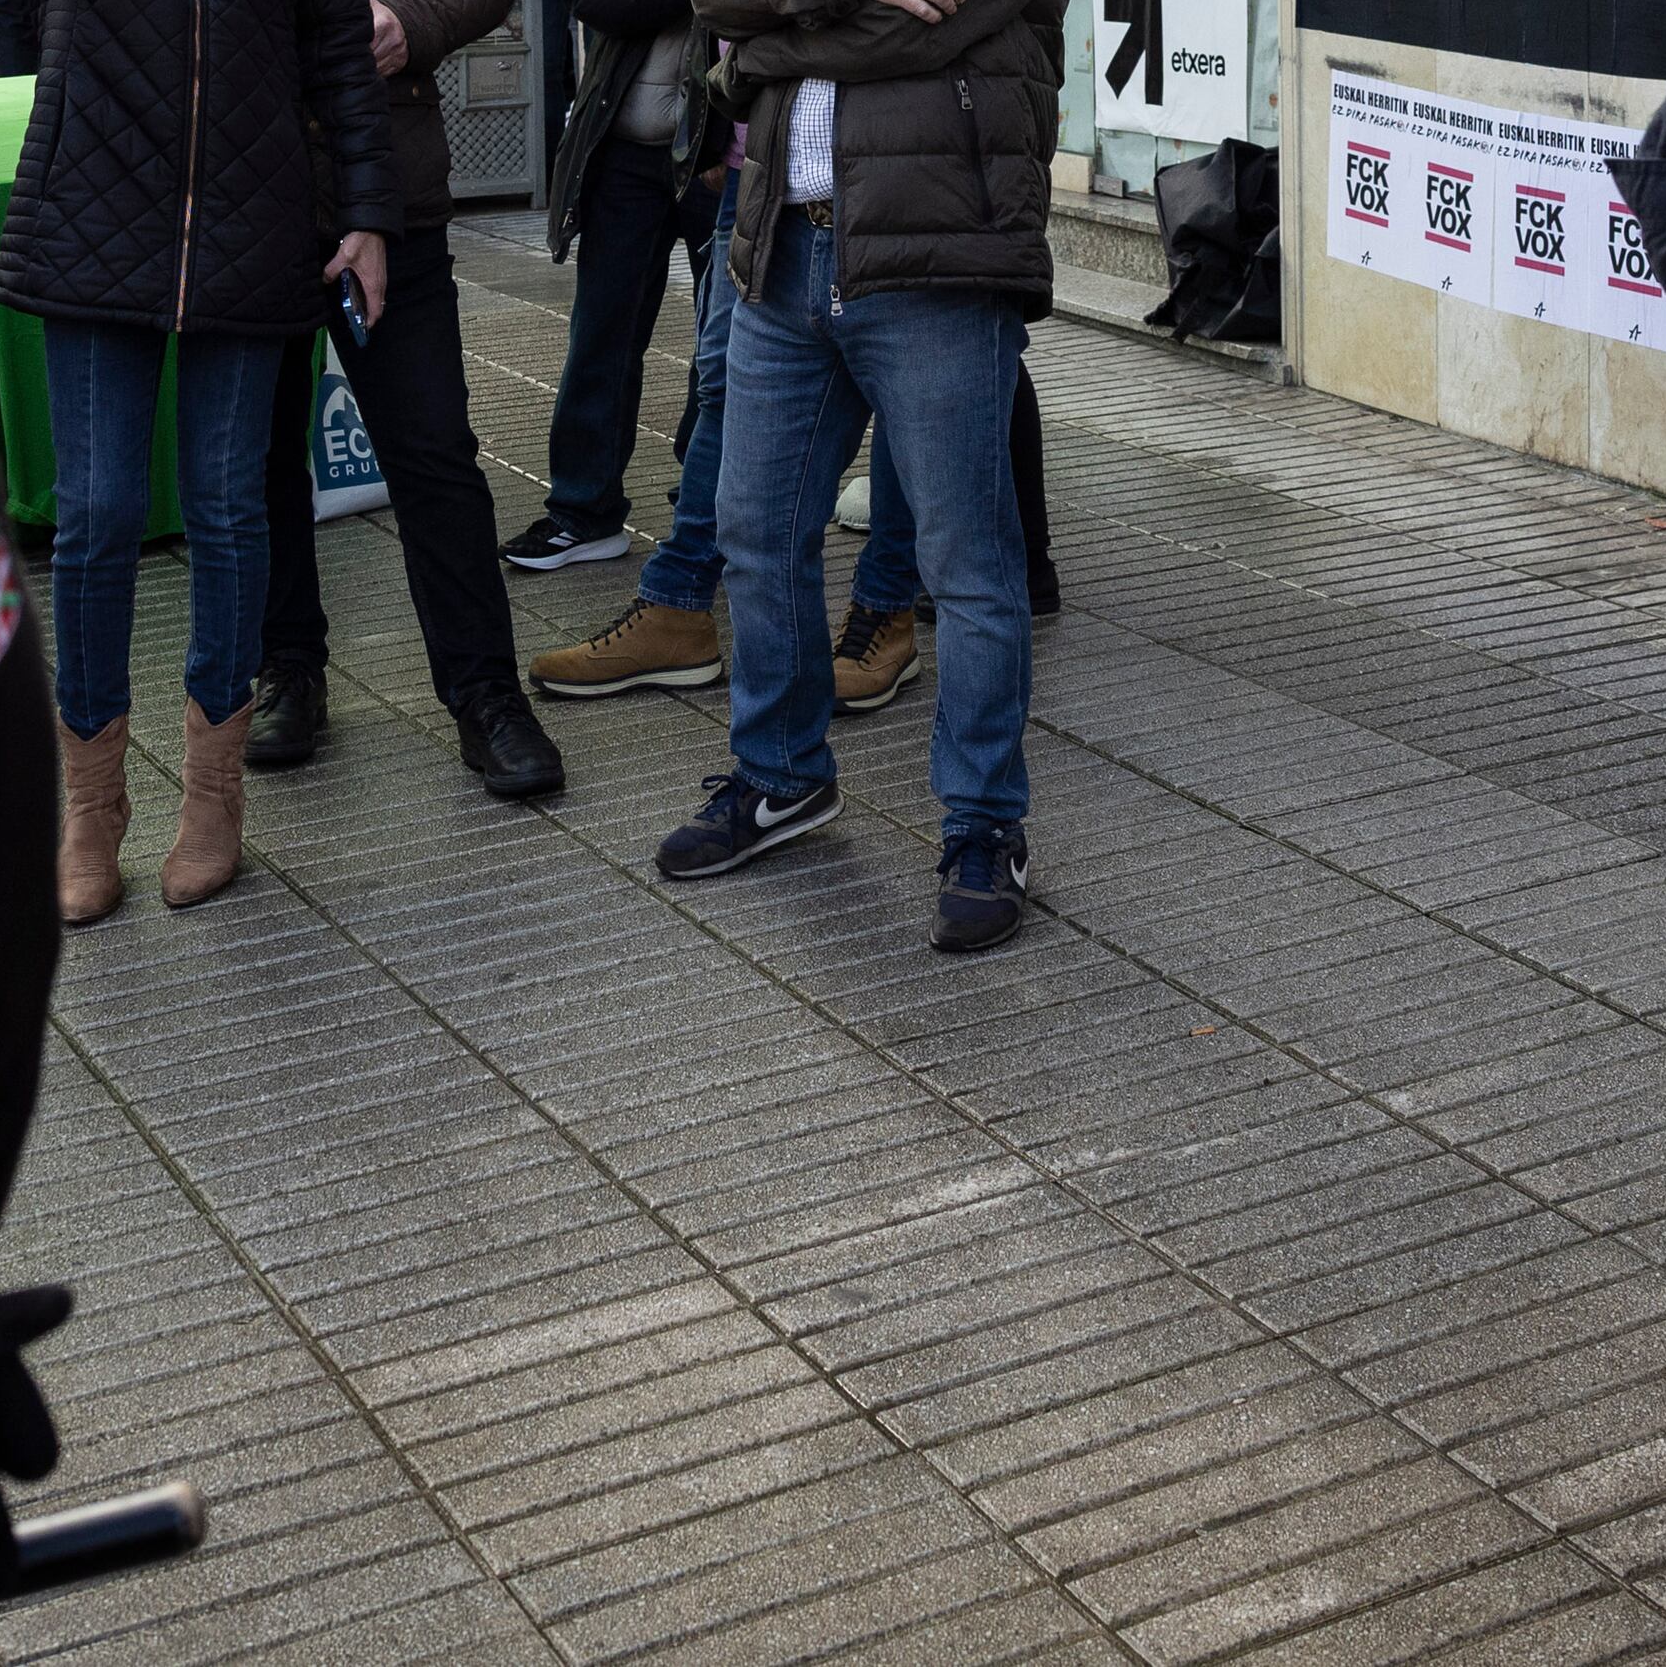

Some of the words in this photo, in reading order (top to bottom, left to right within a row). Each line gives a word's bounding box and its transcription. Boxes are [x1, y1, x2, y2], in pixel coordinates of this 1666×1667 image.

[1171, 47, 1226, 77] etxera
[1332, 104, 1344, 116] EZ
[1346, 108, 1367, 122] DIRA
[1411, 124, 1425, 136] EZ
[1426, 127, 1448, 143] DIRA
[1497, 145, 1512, 157] EZ
[1513, 148, 1536, 164] DIRA
[1589, 161, 1605, 174] EZ
[1334, 83, 1365, 105] EUSKAL
[1367, 91, 1409, 115] HERRITIK
[1413, 102, 1447, 125] EUSKAL
[1449, 111, 1493, 136] HERRITIK
[1499, 123, 1535, 144] EUSKAL
[1537, 128, 1585, 153] HERRITIK
[1590, 137, 1631, 158] EUSKAL
[1346, 153, 1389, 188] FCK
[1346, 179, 1389, 216] VOX
[1427, 174, 1472, 212] FCK
[1426, 201, 1472, 240] VOX
[1515, 197, 1564, 233] FCK
[1608, 215, 1642, 248] FC
[1515, 225, 1565, 263] VOX
[324, 428, 372, 463] EC
